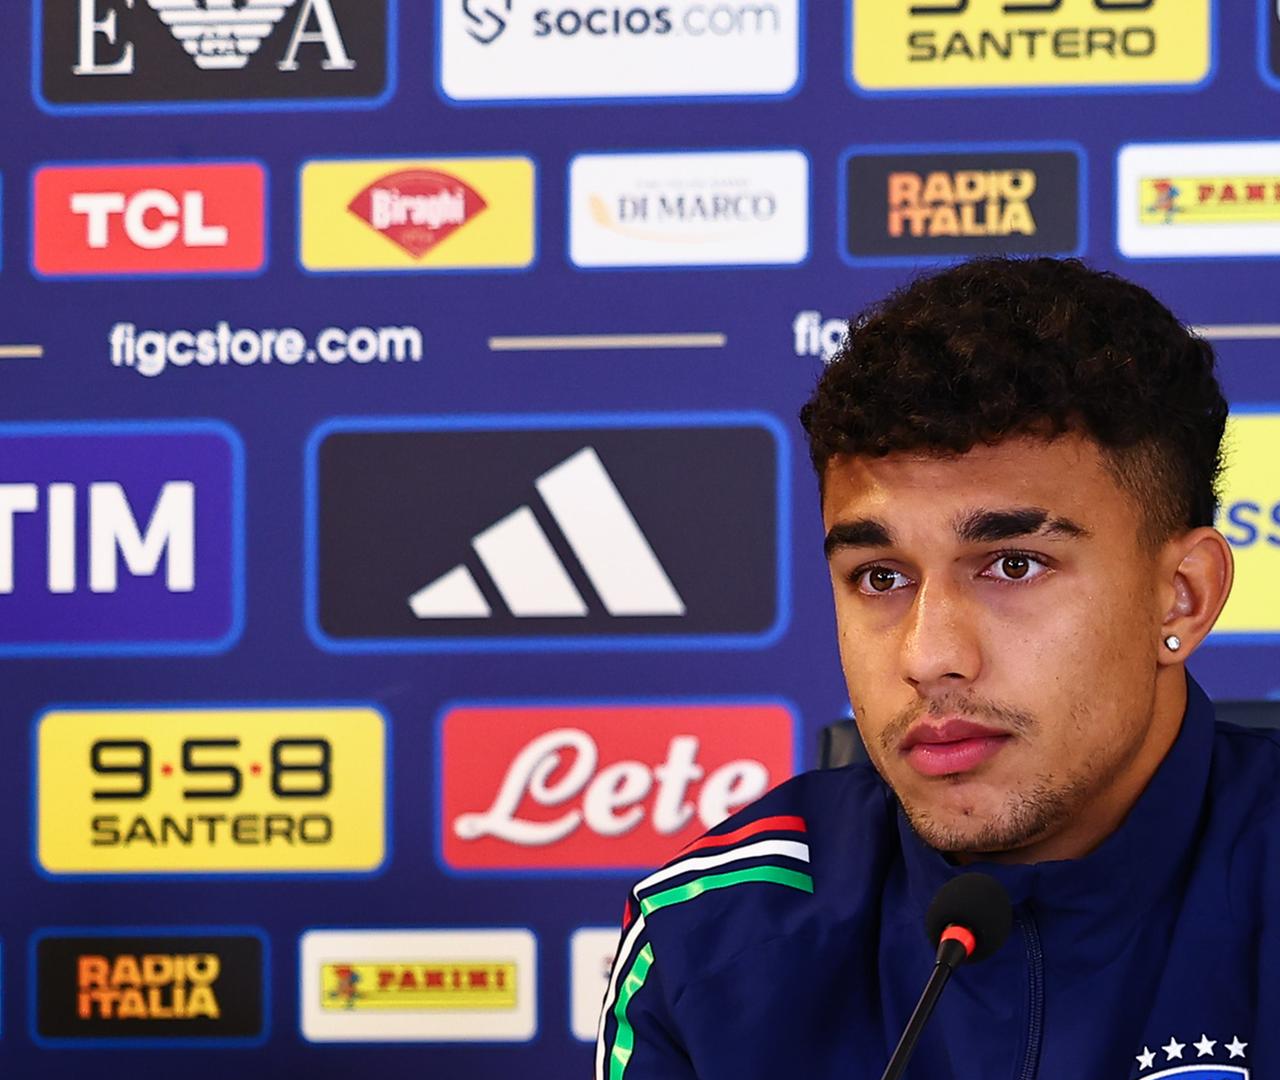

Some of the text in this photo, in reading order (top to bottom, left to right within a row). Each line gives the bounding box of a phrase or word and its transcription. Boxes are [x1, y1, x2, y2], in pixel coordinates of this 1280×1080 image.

[908, 27, 1156, 62] SANTERO
[888, 169, 1035, 204] RADIO
[71, 191, 228, 248] TCL
[888, 202, 1035, 237] ITALIA
[109, 322, 423, 377] figcstore.com
[454, 726, 770, 847] Lete
[90, 813, 334, 847] SANTERO
[76, 954, 221, 988] RADIO
[376, 968, 510, 993] PANINI
[76, 986, 221, 1020] ITALIA
